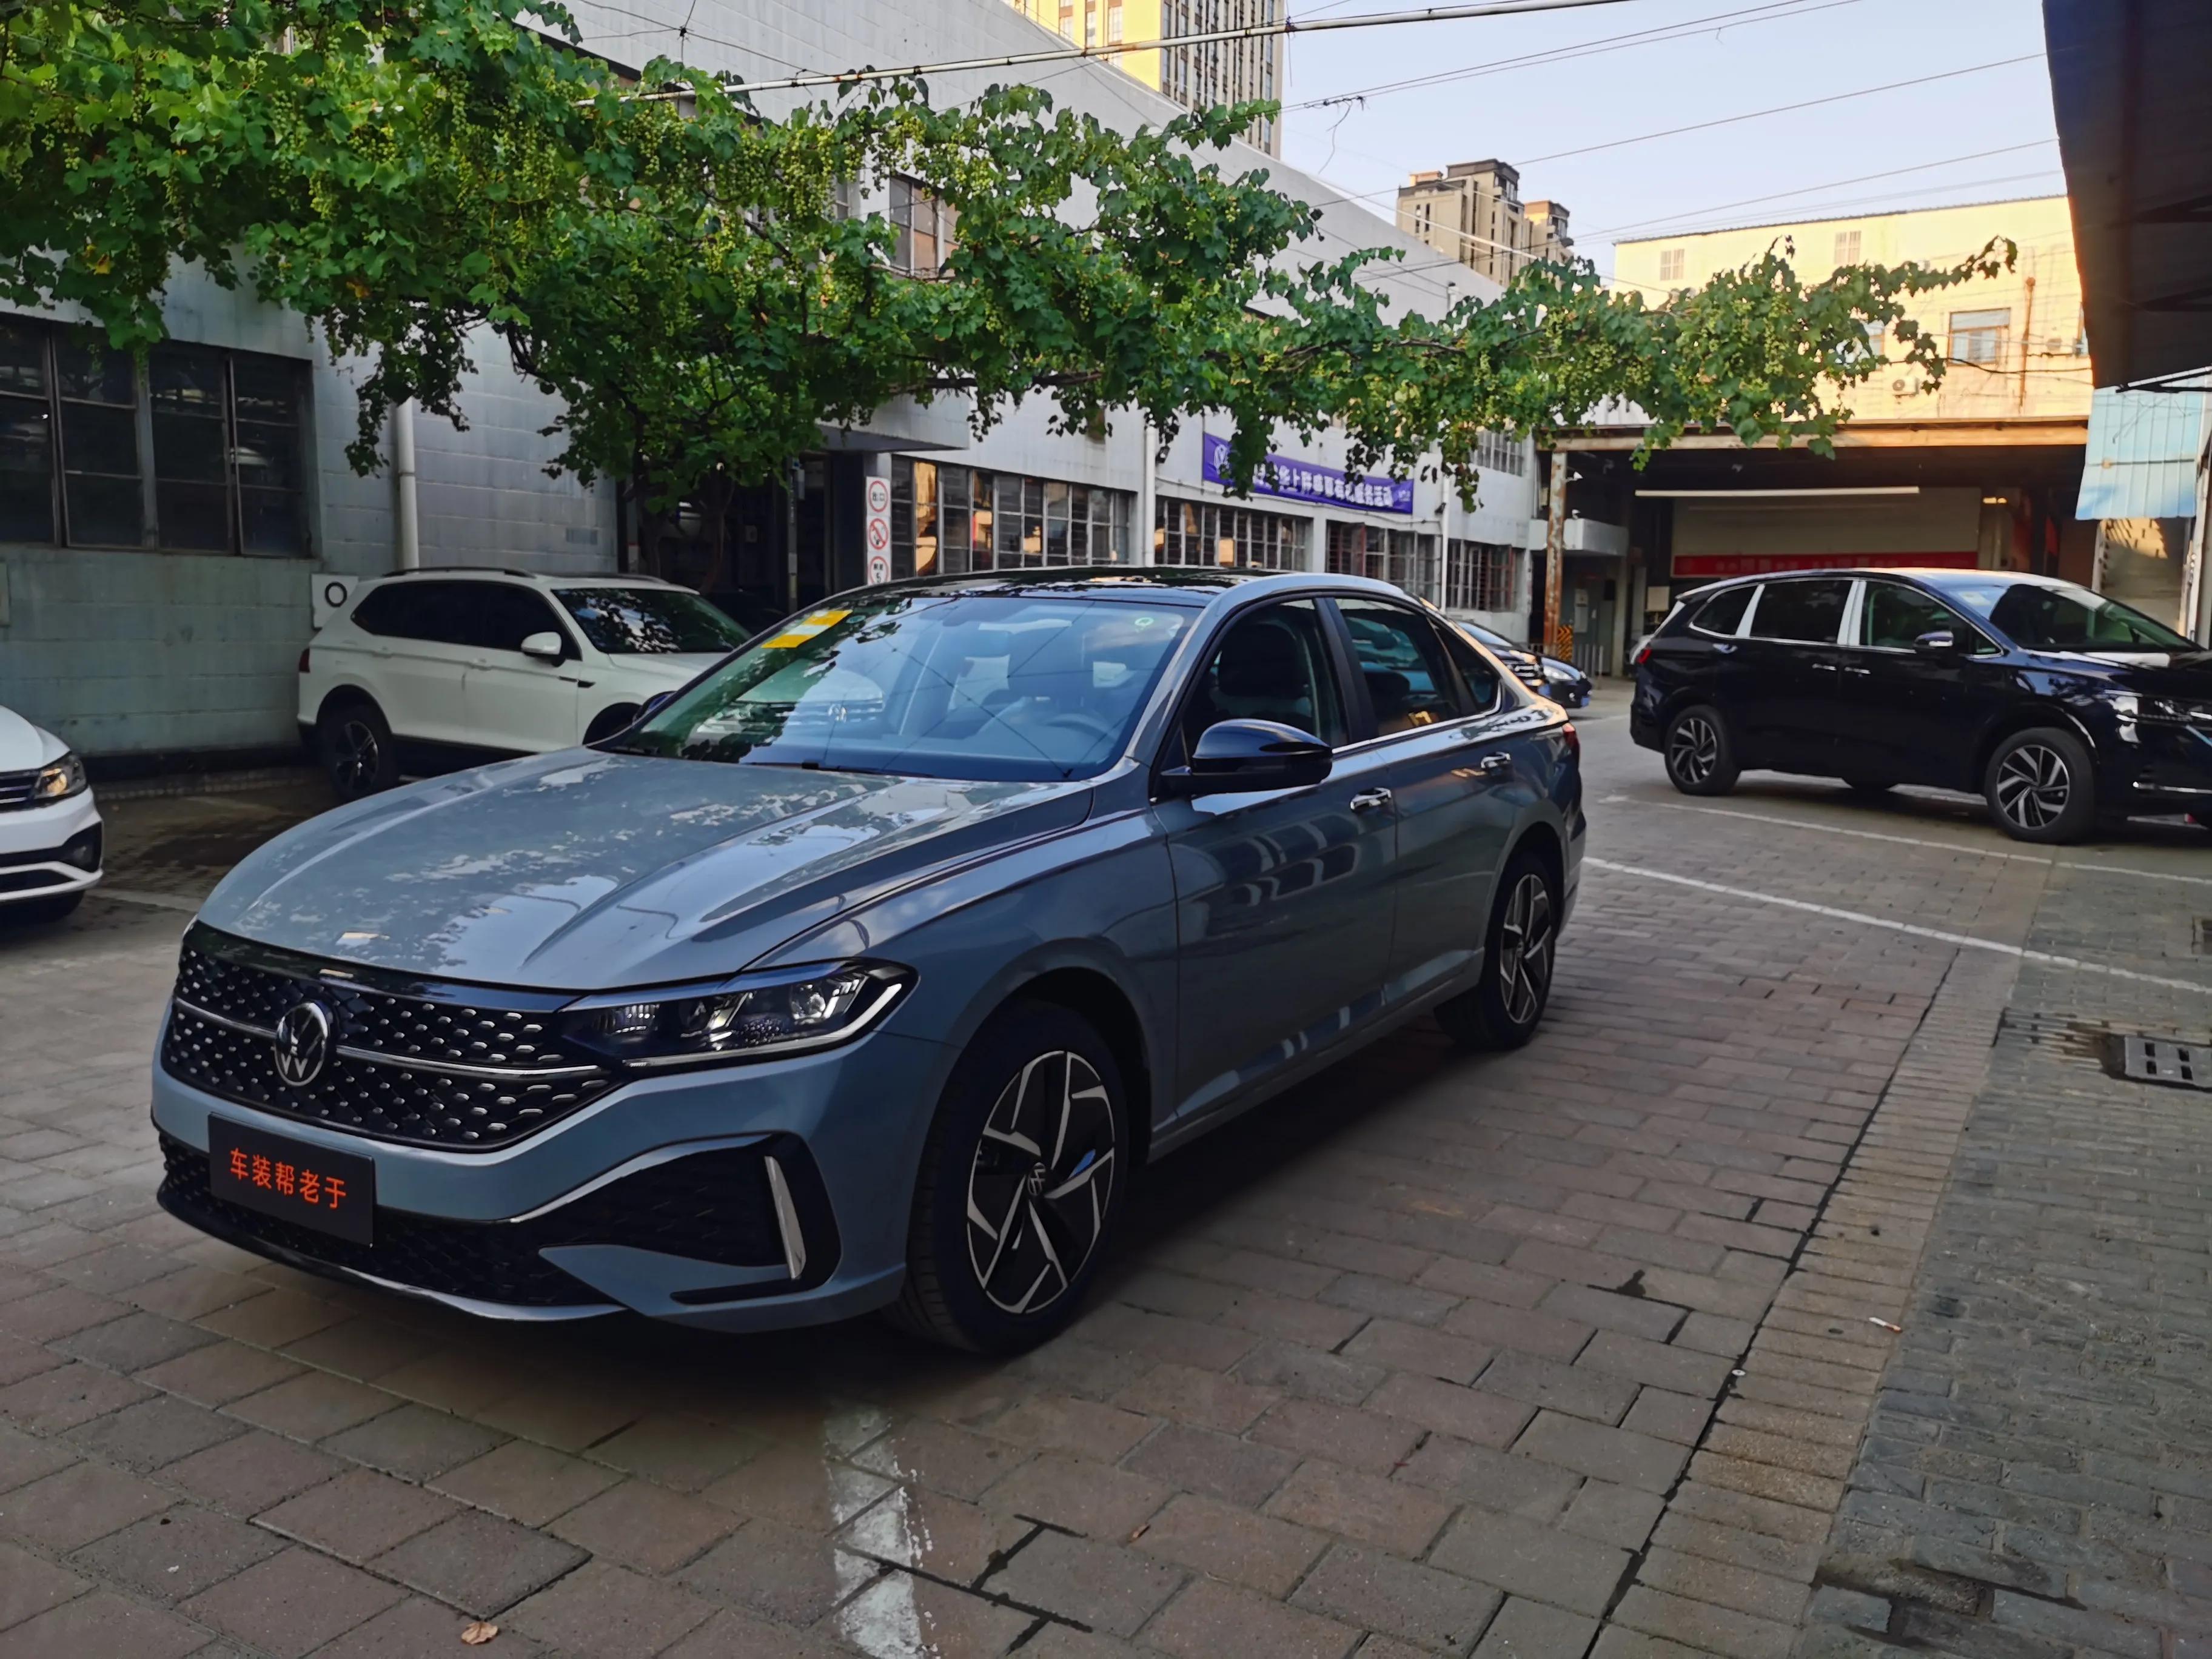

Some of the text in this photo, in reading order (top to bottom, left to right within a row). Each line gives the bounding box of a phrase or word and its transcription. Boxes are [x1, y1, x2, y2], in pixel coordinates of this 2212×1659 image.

[230, 1147, 347, 1210] 车装帮老于
